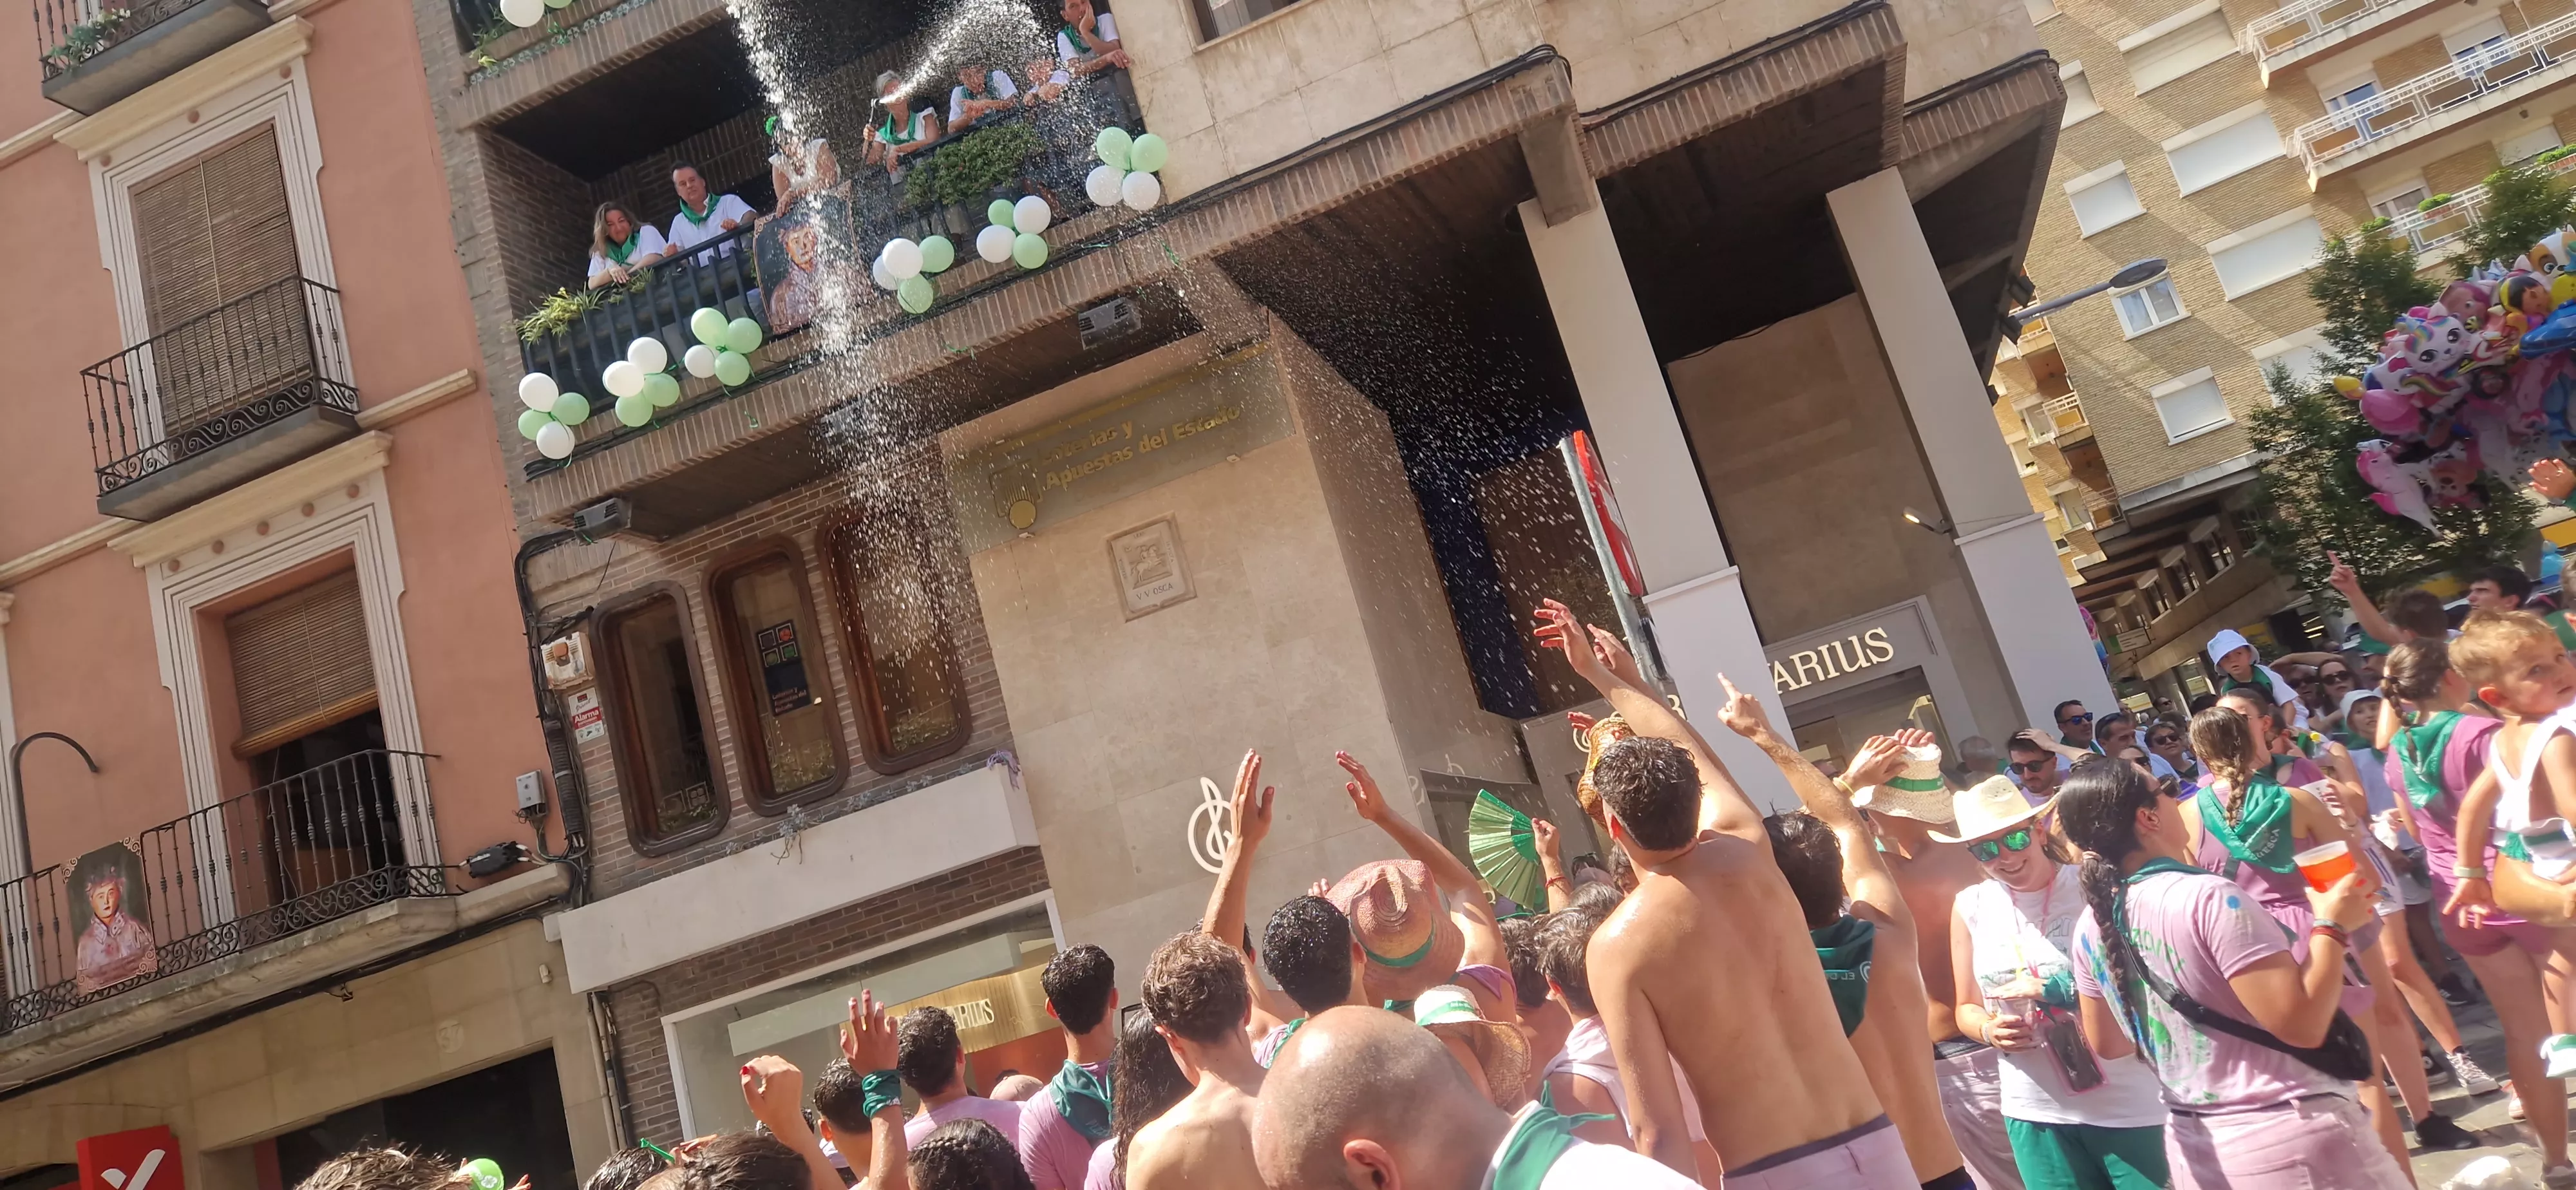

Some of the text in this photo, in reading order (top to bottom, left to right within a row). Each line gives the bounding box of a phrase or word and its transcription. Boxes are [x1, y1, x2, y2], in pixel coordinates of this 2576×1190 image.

[1121, 420, 1132, 440] y
[1046, 445, 1133, 489] Apuestas
[1139, 428, 1168, 453] del
[1171, 404, 1241, 440] Estado
[1153, 583, 1173, 595] OSCA
[1766, 627, 1894, 695] ARIUS
[574, 710, 600, 724] Alarma
[2255, 828, 2280, 858] UESCA
